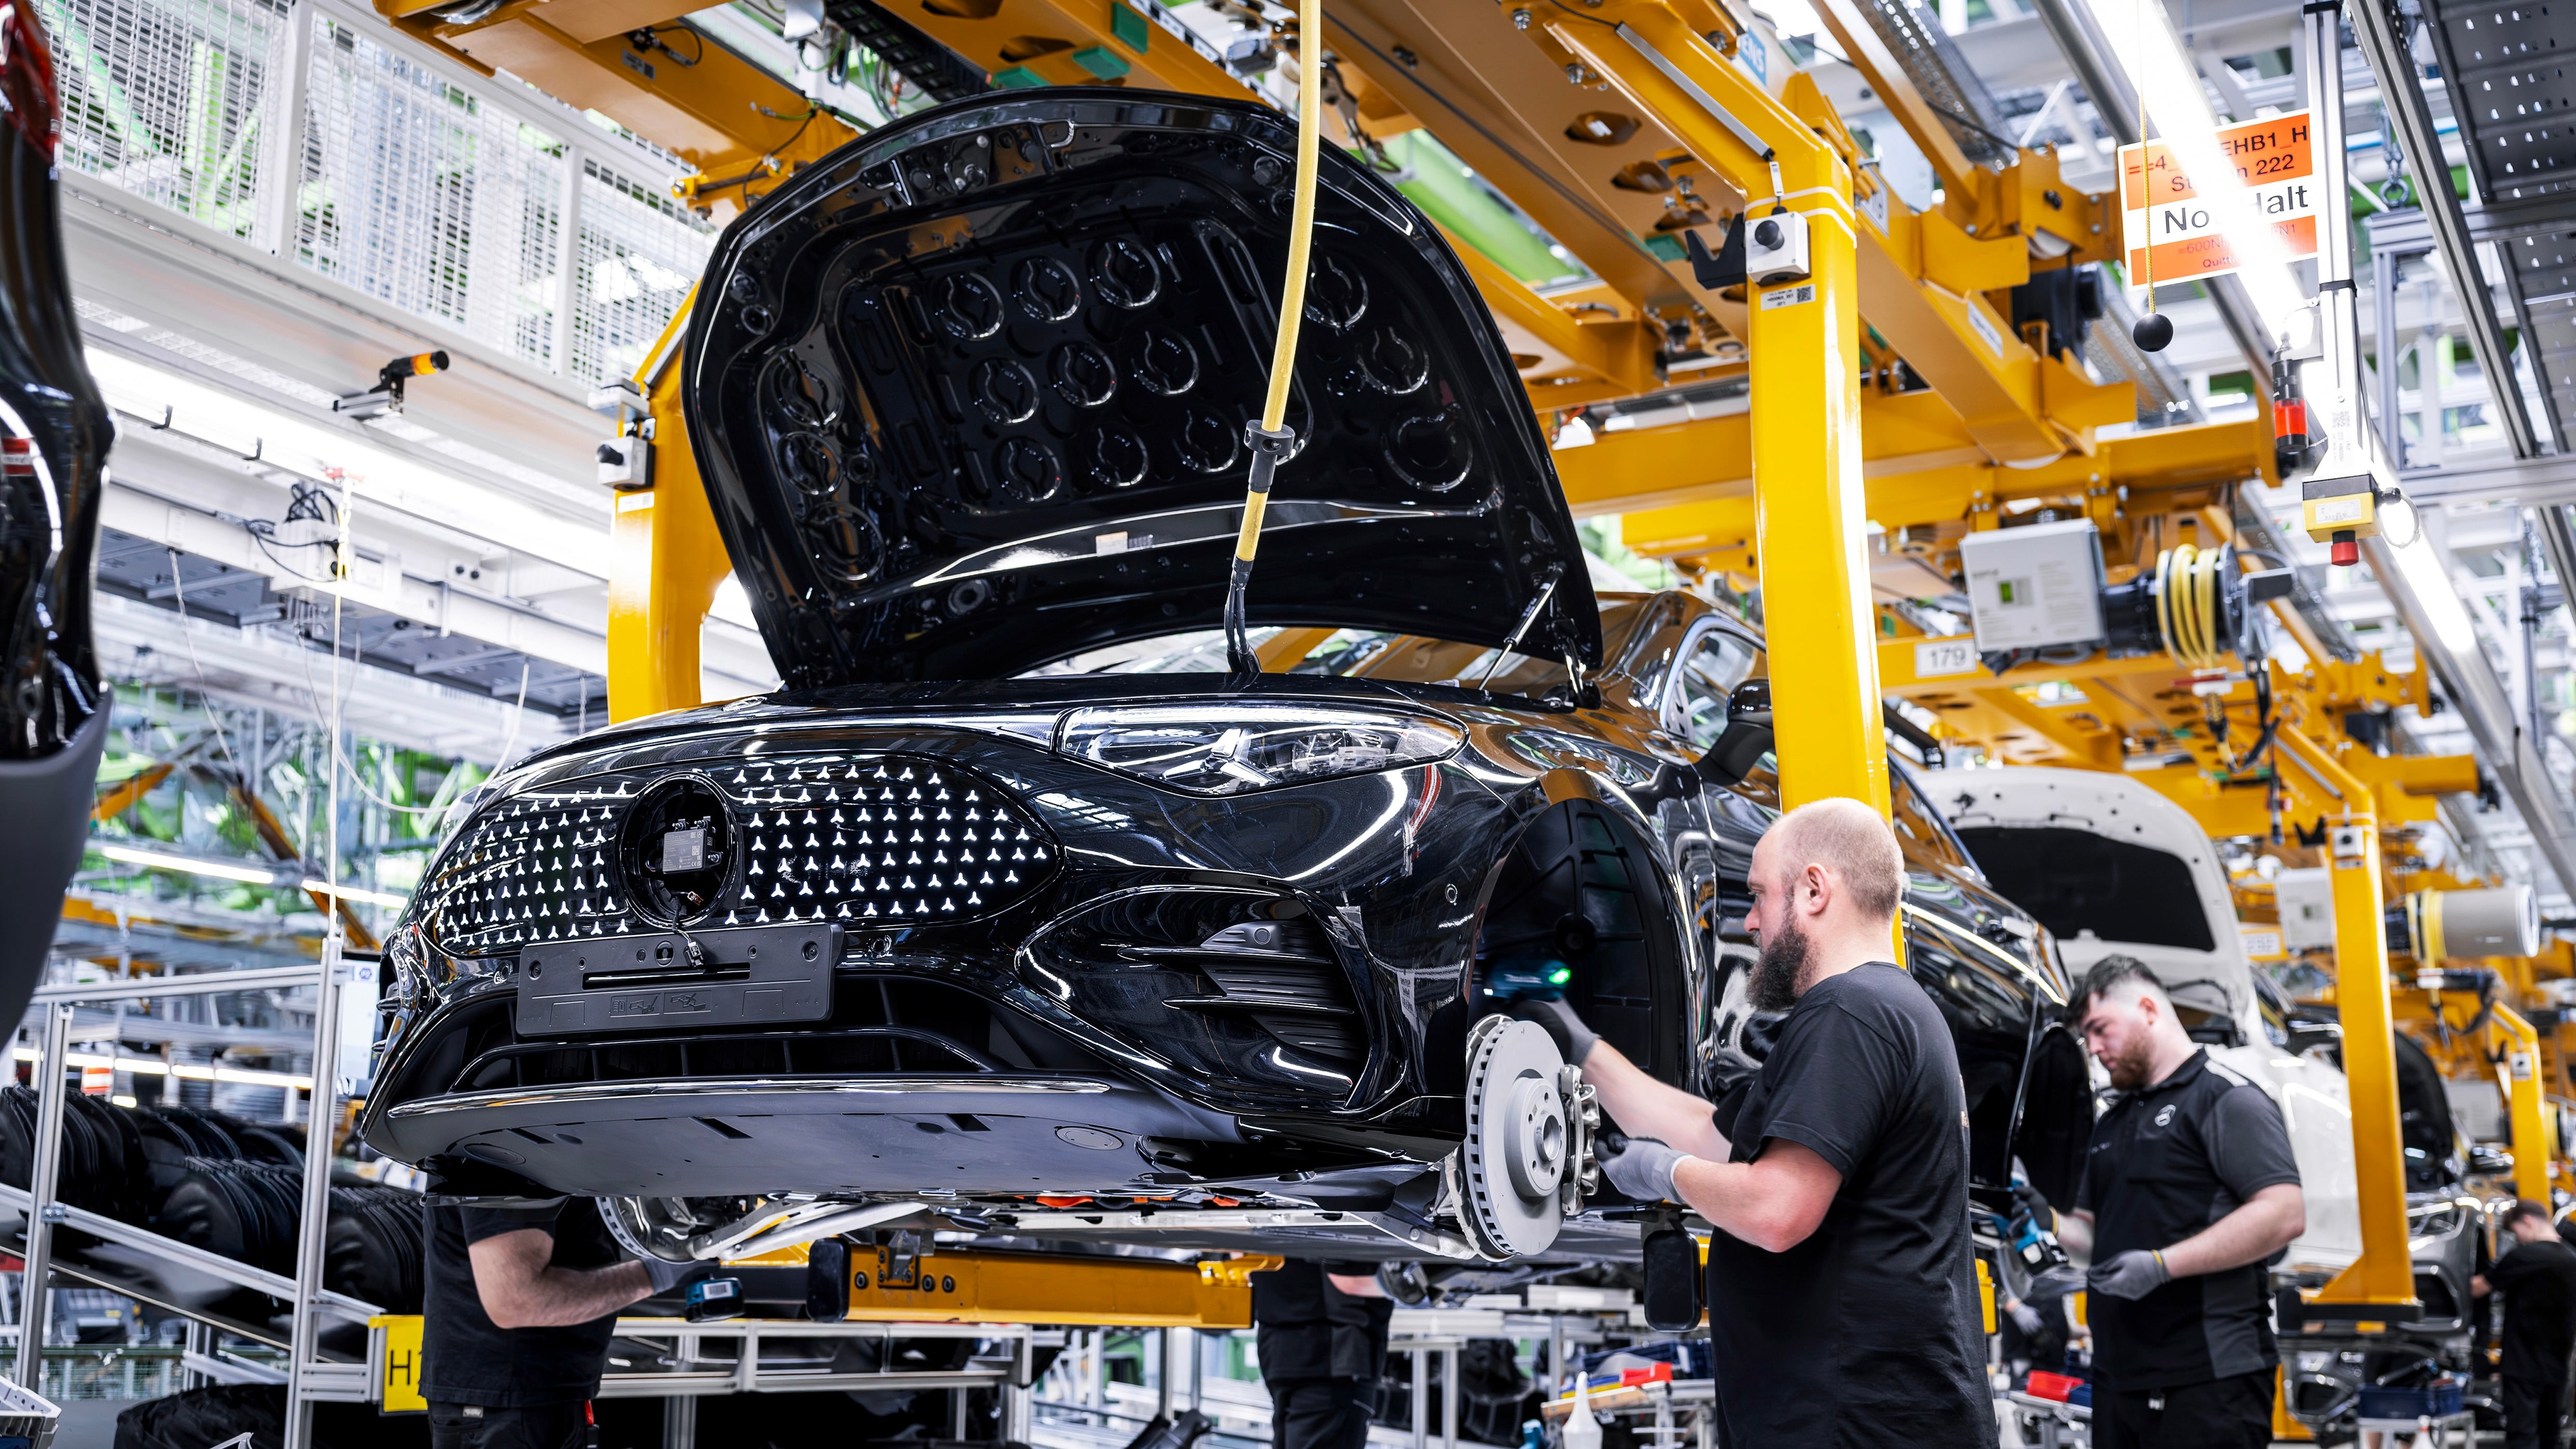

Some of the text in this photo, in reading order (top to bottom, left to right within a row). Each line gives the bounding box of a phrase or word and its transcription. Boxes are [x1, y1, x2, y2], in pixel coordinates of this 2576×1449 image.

[2256, 154, 2295, 176] 222
[1930, 645, 1966, 668] 179
[389, 1349, 422, 1386] H
